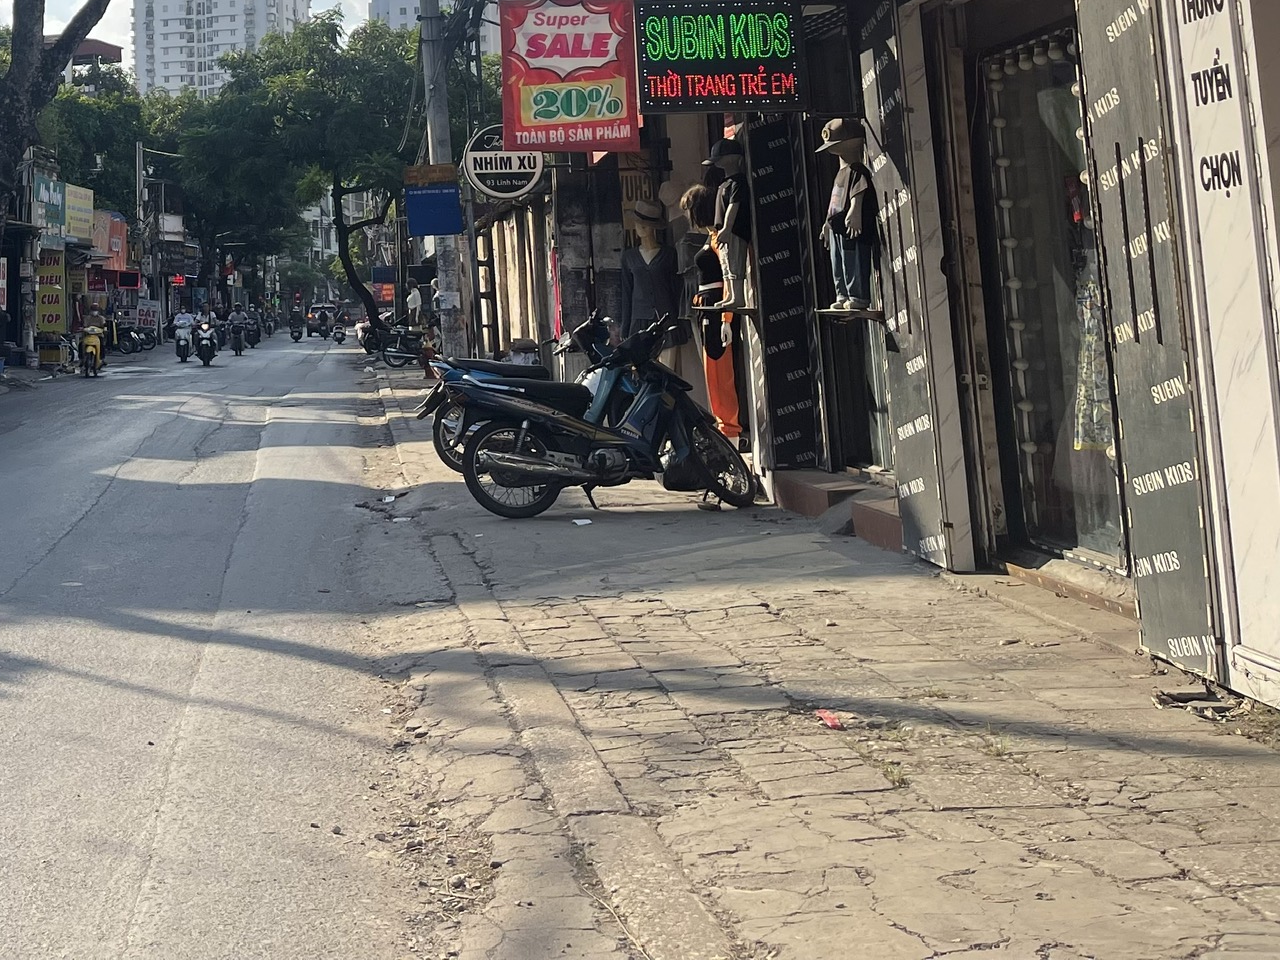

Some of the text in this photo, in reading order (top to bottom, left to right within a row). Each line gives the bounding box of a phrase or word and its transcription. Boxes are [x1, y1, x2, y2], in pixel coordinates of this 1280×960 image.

[532, 11, 590, 30] Super
[645, 11, 792, 61] SUBIN KIDS
[1105, 4, 1138, 44] SUBIN
[524, 32, 614, 60] SALE
[647, 65, 796, 98] THỜI TRANG TRẺ EM
[1191, 48, 1233, 107] TUYỂN
[532, 83, 624, 121] 20%
[1094, 87, 1121, 119] KIDS
[516, 120, 631, 146] TOÀN BỘ SẢN PHẨM
[472, 151, 538, 171] NHÍM XÙ
[1200, 150, 1243, 198] CHỌN
[486, 179, 495, 187] 93
[512, 178, 528, 186] Nam
[41, 293, 60, 305] CUA
[1150, 375, 1186, 406] SUBIN
[1132, 460, 1195, 497] SUBIN KIDS
[1152, 550, 1181, 575] KIDS
[1167, 635, 1202, 659] SUBIN
